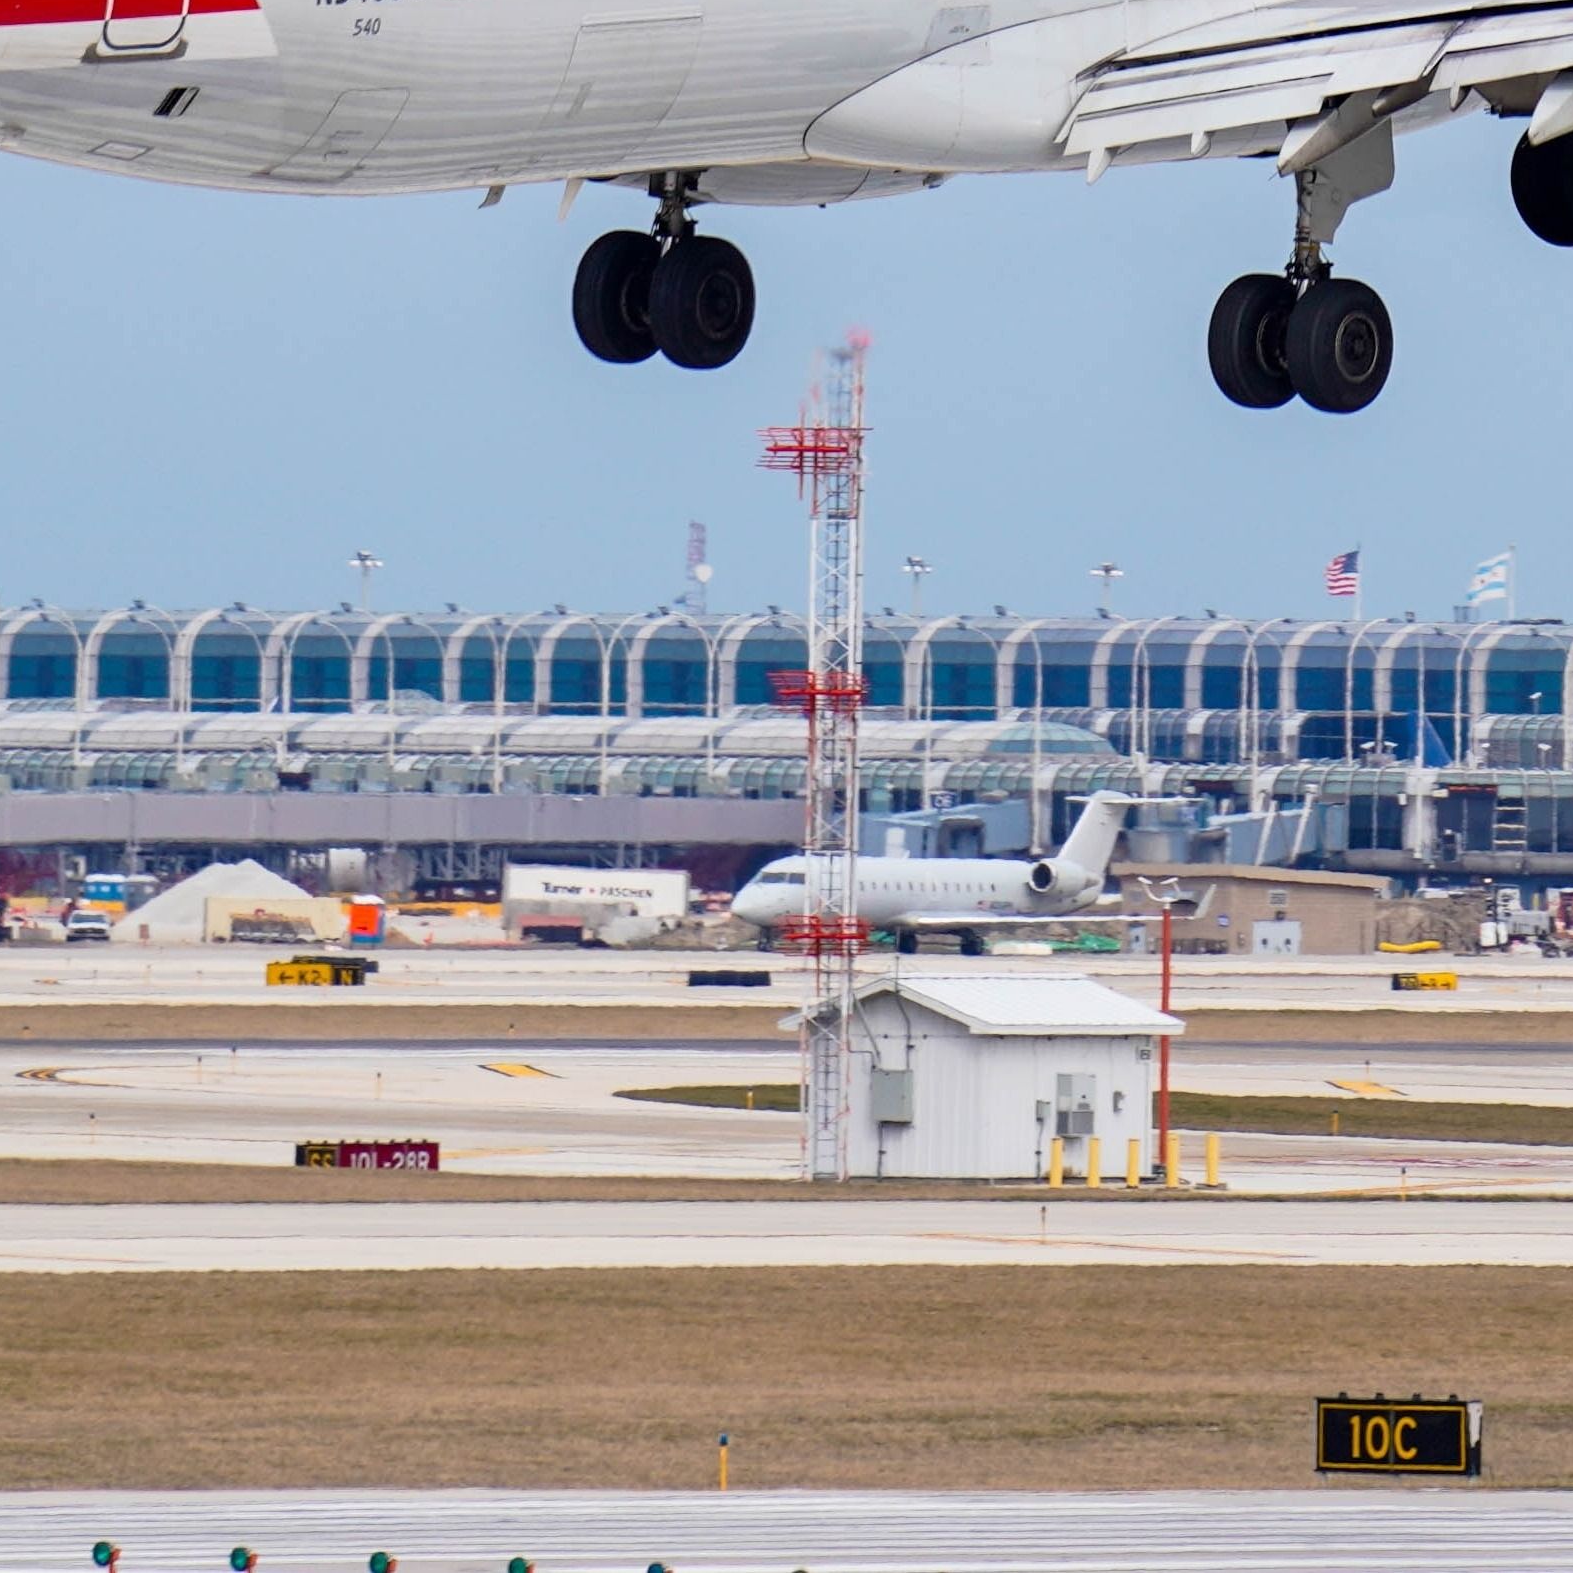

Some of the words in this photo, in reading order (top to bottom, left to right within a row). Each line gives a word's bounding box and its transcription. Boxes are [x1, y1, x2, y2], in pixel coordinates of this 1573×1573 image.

[352, 17, 382, 36] 540
[542, 882, 584, 895] Turner
[599, 886, 654, 899] PASCHEN
[1349, 1414, 1419, 1460] 10C
